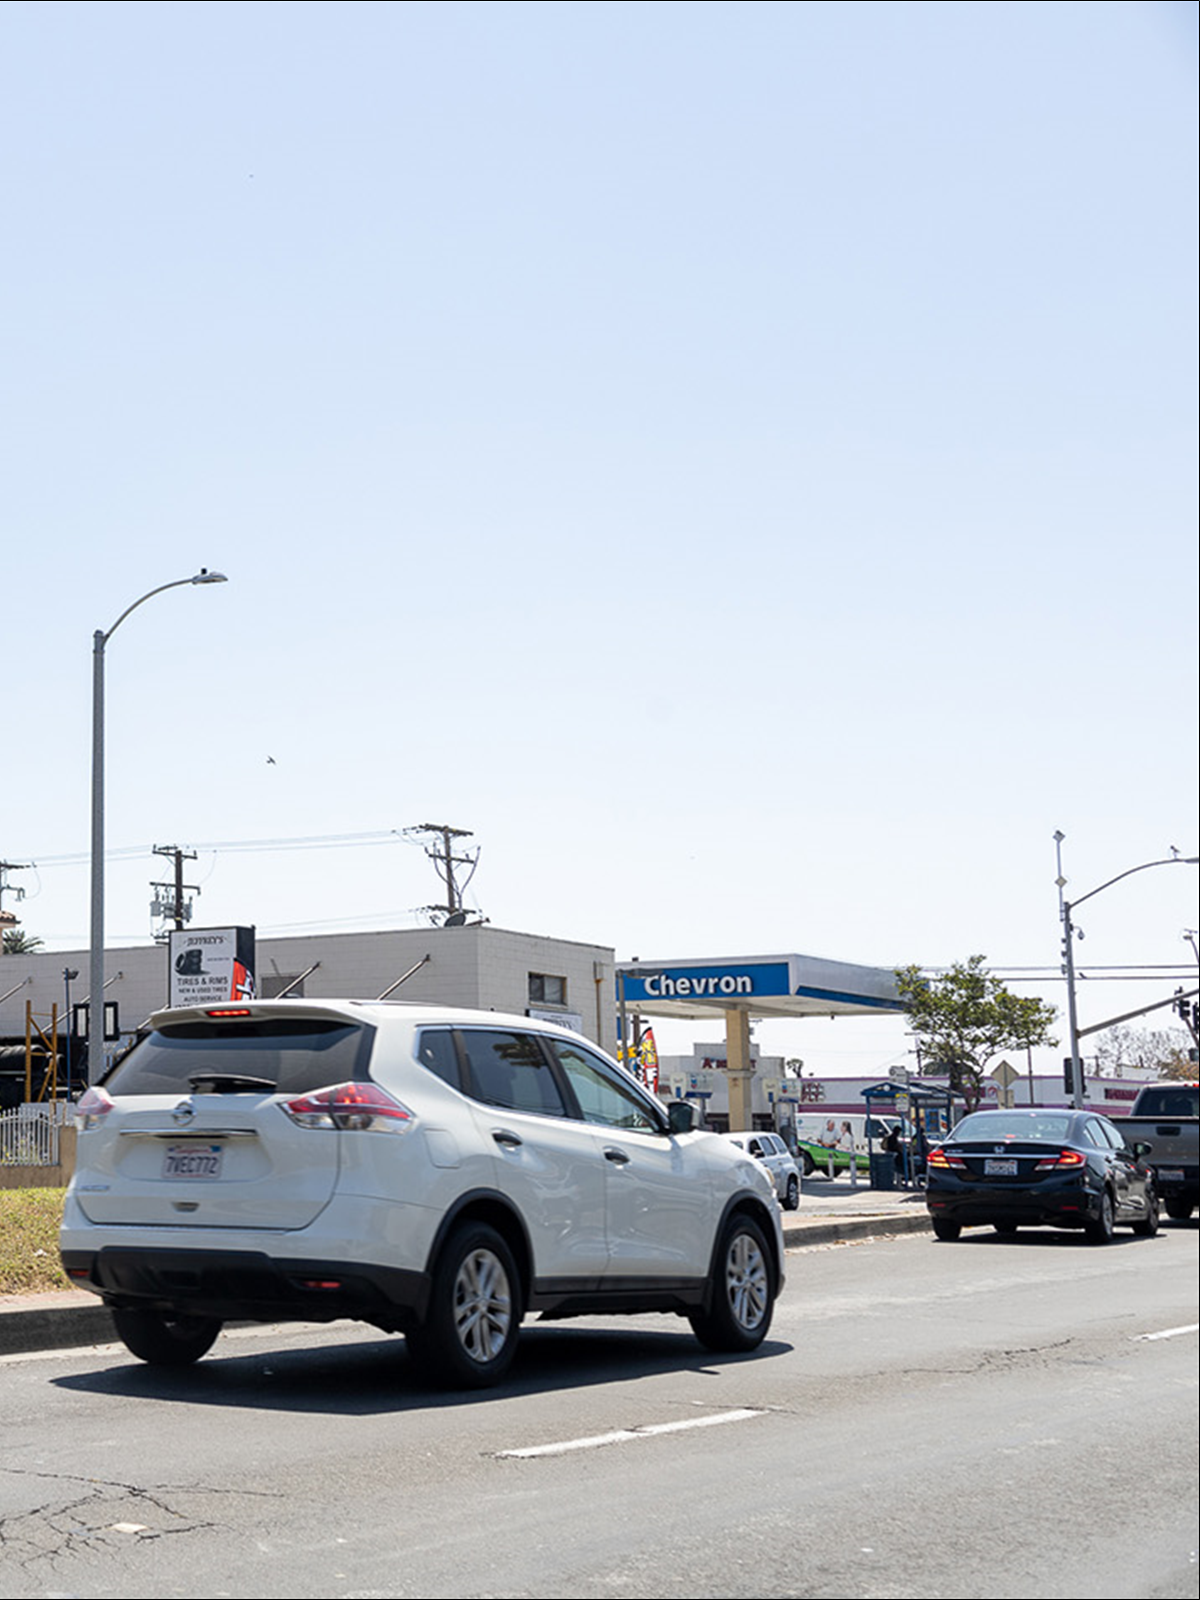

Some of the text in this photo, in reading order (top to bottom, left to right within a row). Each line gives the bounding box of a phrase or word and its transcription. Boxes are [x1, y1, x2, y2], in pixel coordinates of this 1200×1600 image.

[178, 977, 199, 986] TIRES
[201, 977, 207, 986] &
[644, 974, 752, 996] Chevron
